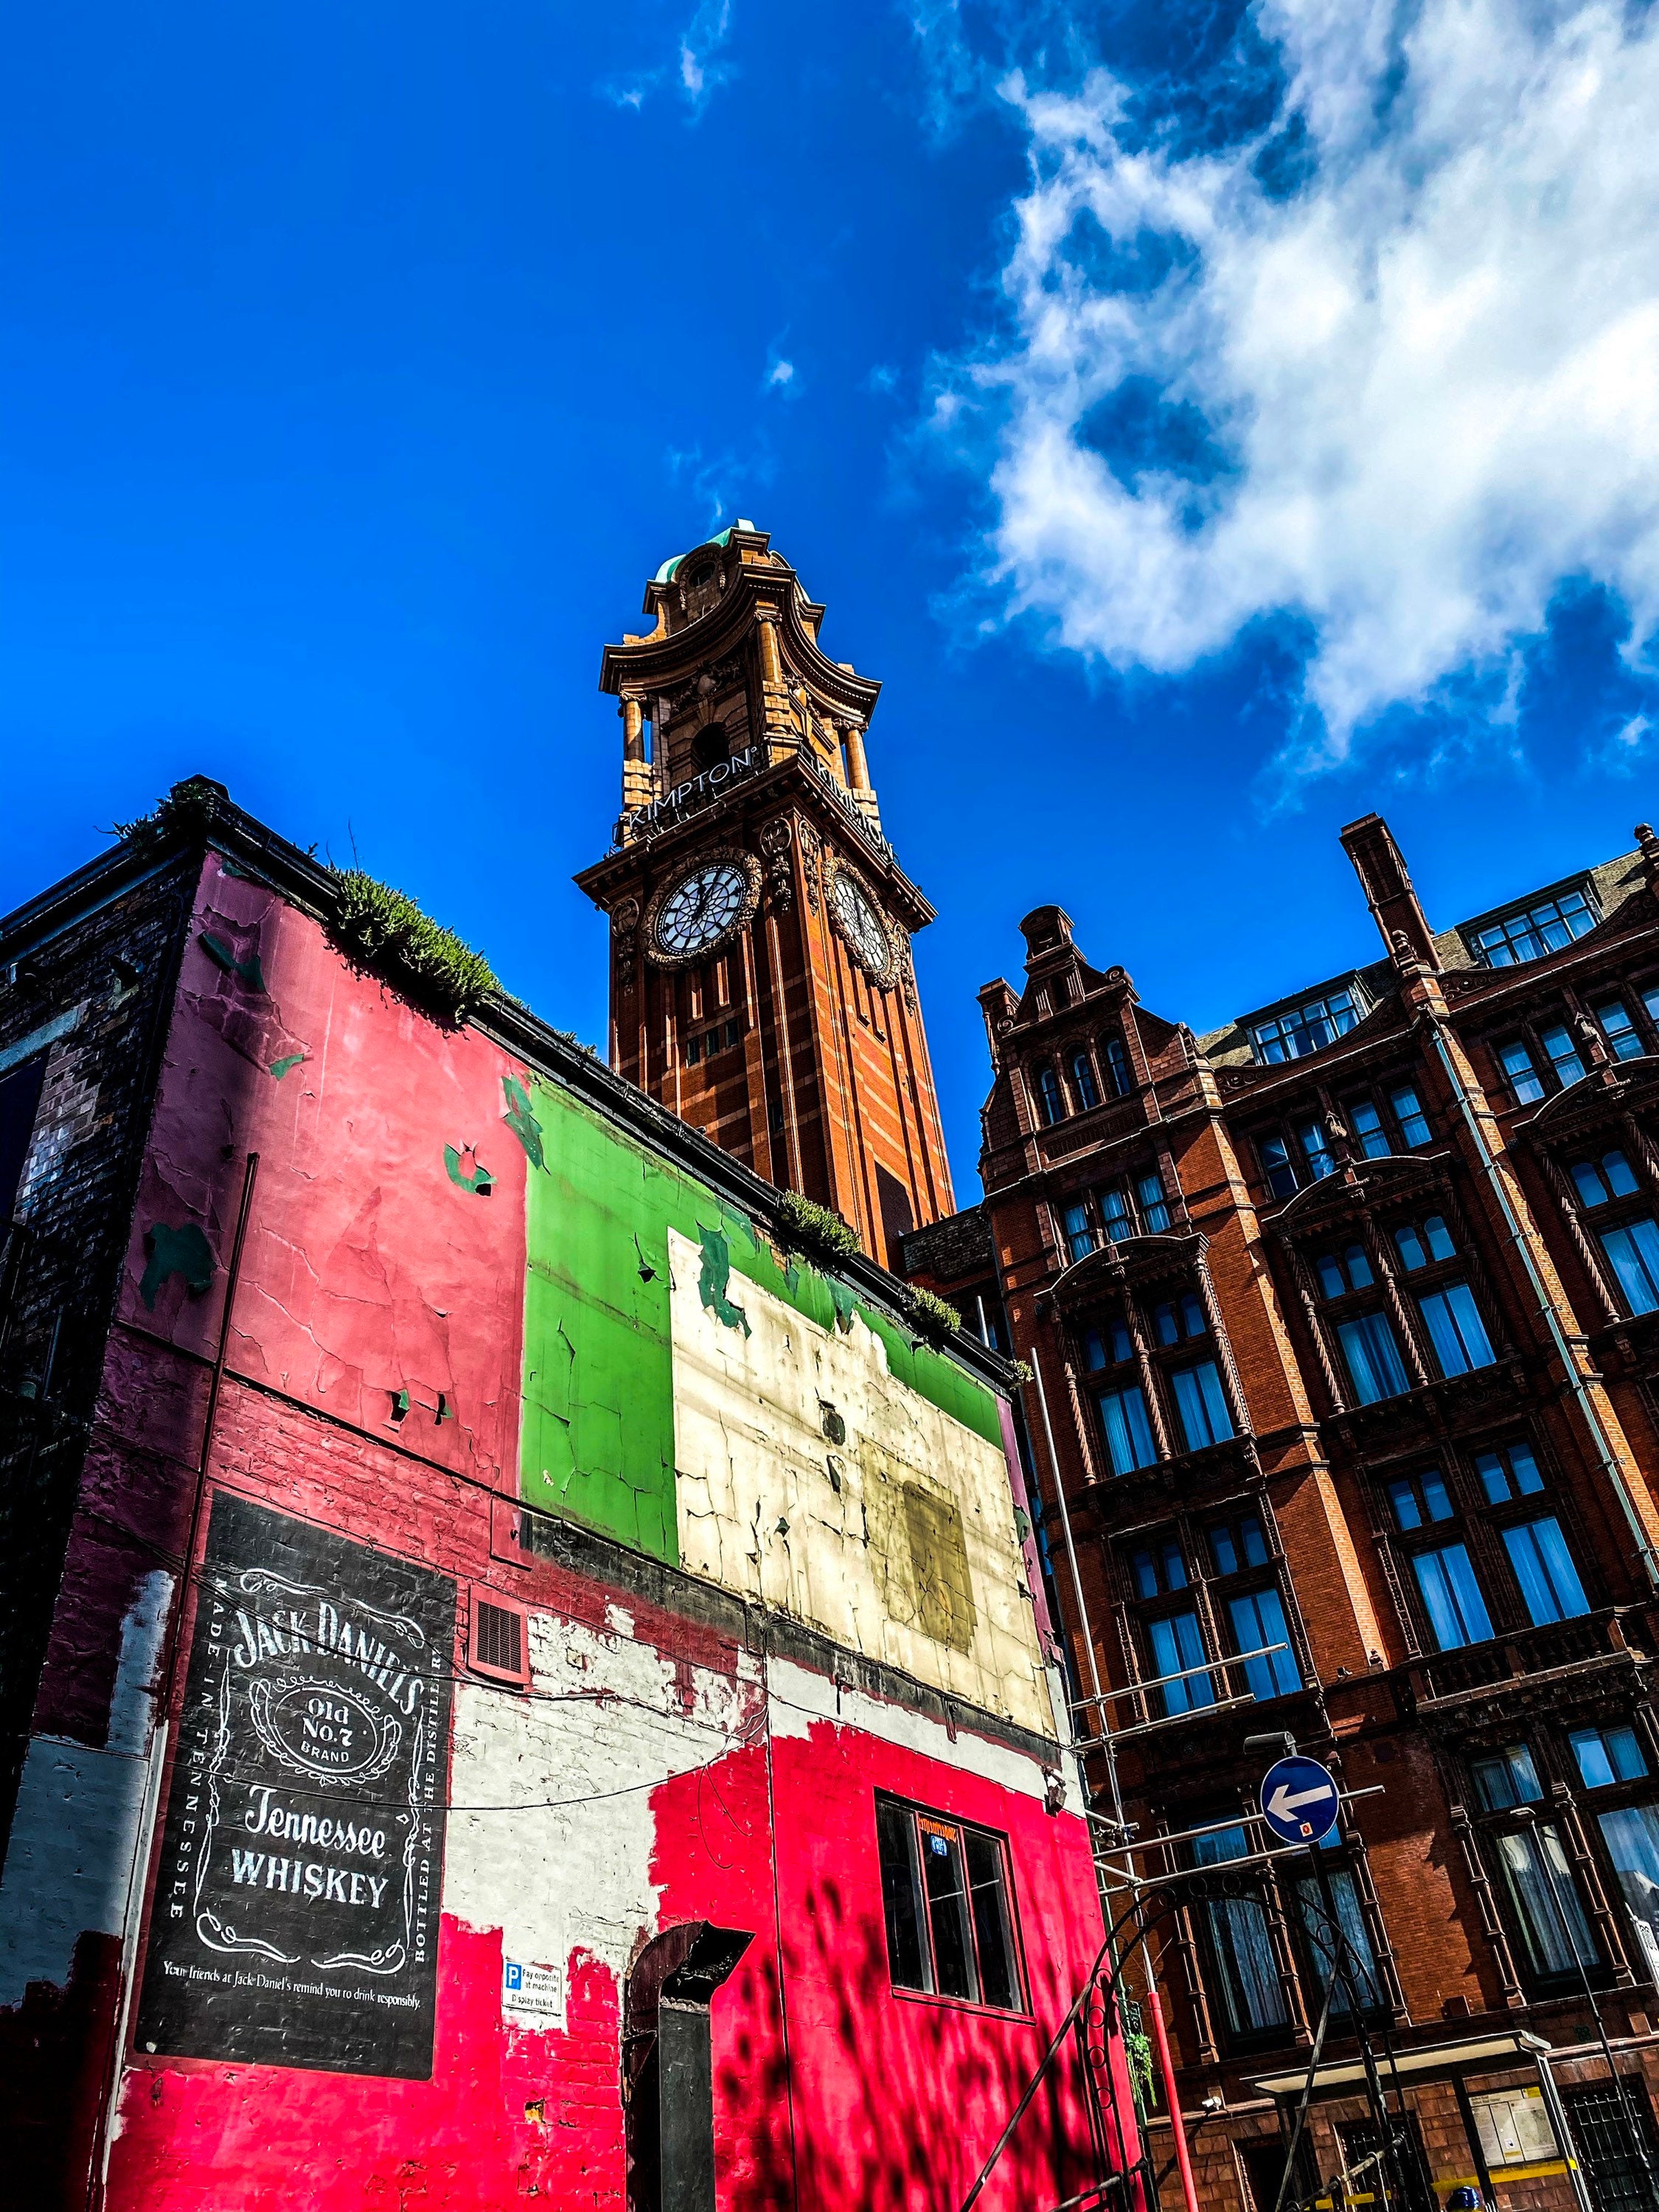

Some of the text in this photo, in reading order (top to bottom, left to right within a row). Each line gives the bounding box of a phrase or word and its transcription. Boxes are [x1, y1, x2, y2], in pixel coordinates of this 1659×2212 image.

[629, 748, 752, 830] KIMPTON
[818, 759, 894, 862] KIMPTON
[234, 1607, 310, 1669] JACK
[308, 1698, 349, 1725] Old
[301, 1740, 349, 1762] BRAND
[170, 1728, 208, 1918] TENNESSEE
[245, 1785, 386, 1858] Tennessee
[414, 1649, 441, 1963] BOTTLED AT THE DISTILLR
[232, 1848, 389, 1909] WHISKEY
[164, 1961, 421, 2011] Your friends at Jack Daniel's remind you to drink responsibly.
[507, 1966, 519, 1986] P
[522, 1969, 559, 1983] Pay opposite
[532, 1983, 557, 1993] machine
[535, 1998, 553, 2008] ticket
